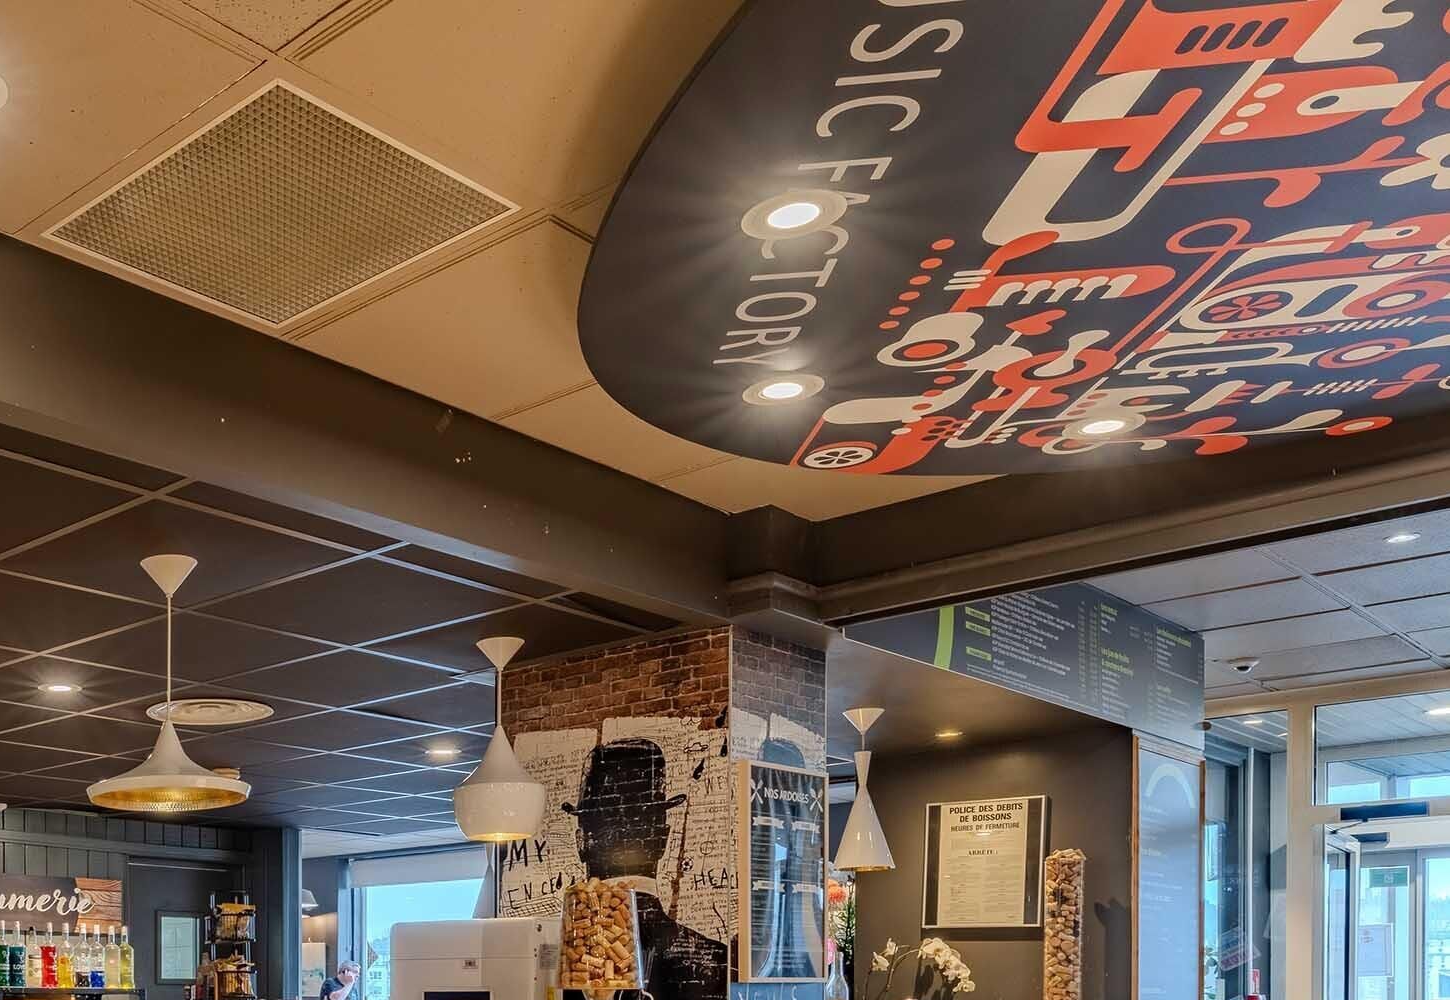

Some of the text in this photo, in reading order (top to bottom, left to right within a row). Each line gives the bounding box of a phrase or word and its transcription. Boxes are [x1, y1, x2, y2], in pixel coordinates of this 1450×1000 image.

[712, 0, 968, 372] SIC FCTORY
[763, 786, 810, 804] NOS ARDOISES
[949, 802, 1023, 815] POLICE DES DEBITS
[959, 812, 1012, 823] DE BOISSONS
[950, 825, 974, 833] HEURES
[985, 822, 1020, 831] FERMETURE
[508, 839, 547, 872] MY
